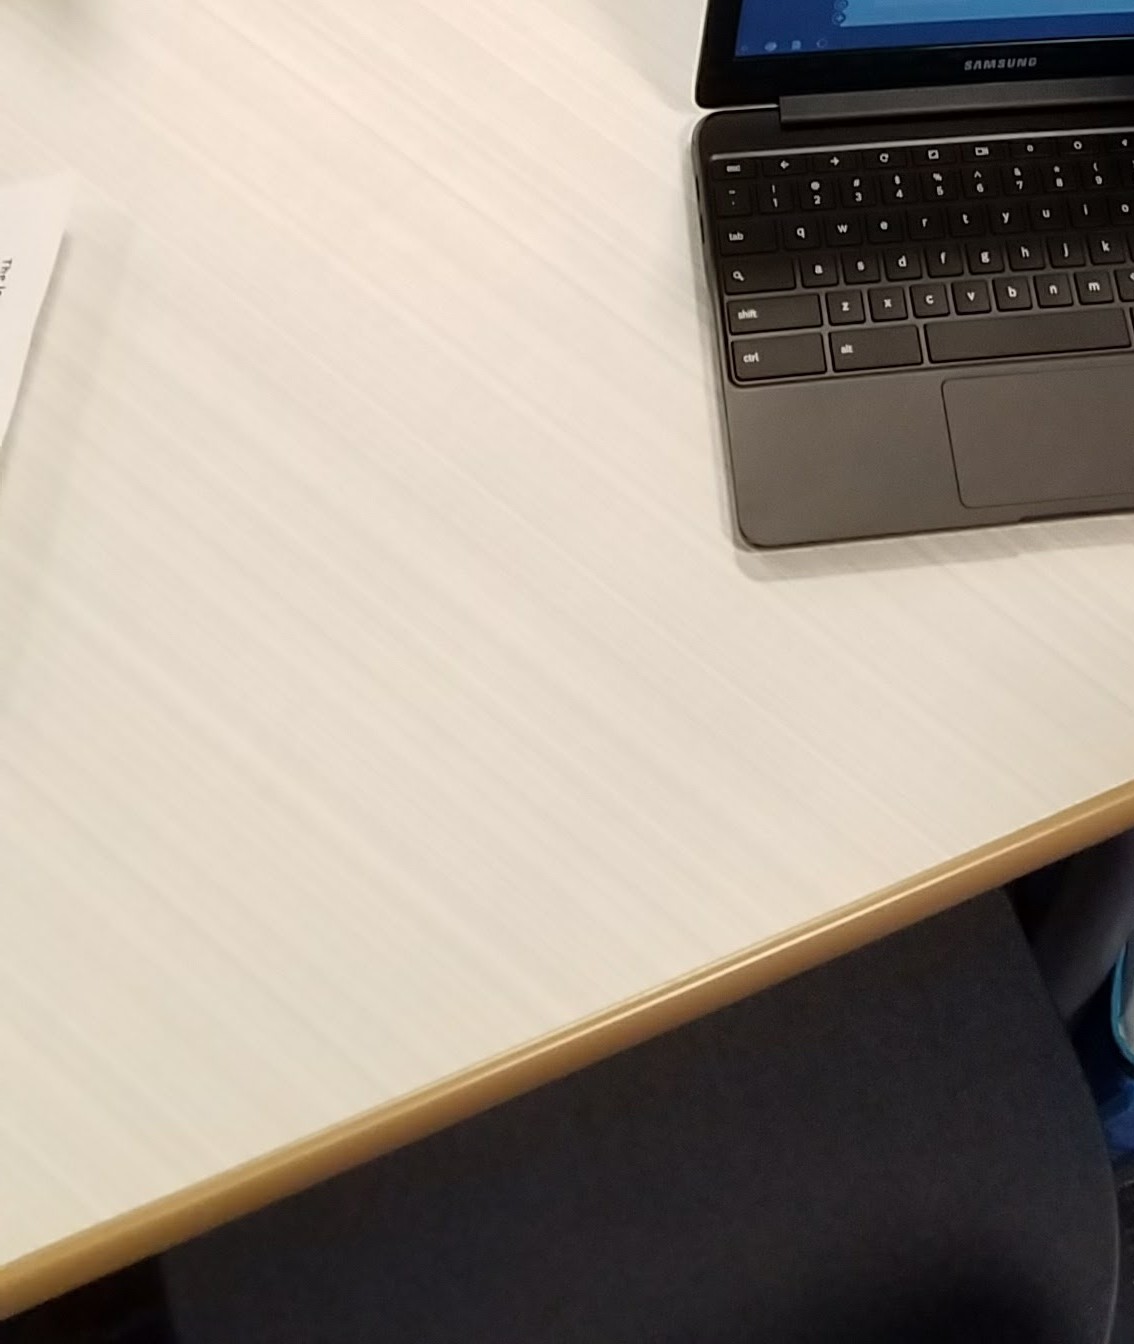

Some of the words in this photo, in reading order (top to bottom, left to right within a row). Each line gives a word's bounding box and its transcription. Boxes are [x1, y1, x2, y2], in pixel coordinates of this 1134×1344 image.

[964, 57, 1037, 71] SAMSUNG
[729, 232, 744, 241] tab
[738, 309, 758, 320] shift
[743, 352, 759, 363] ctrl
